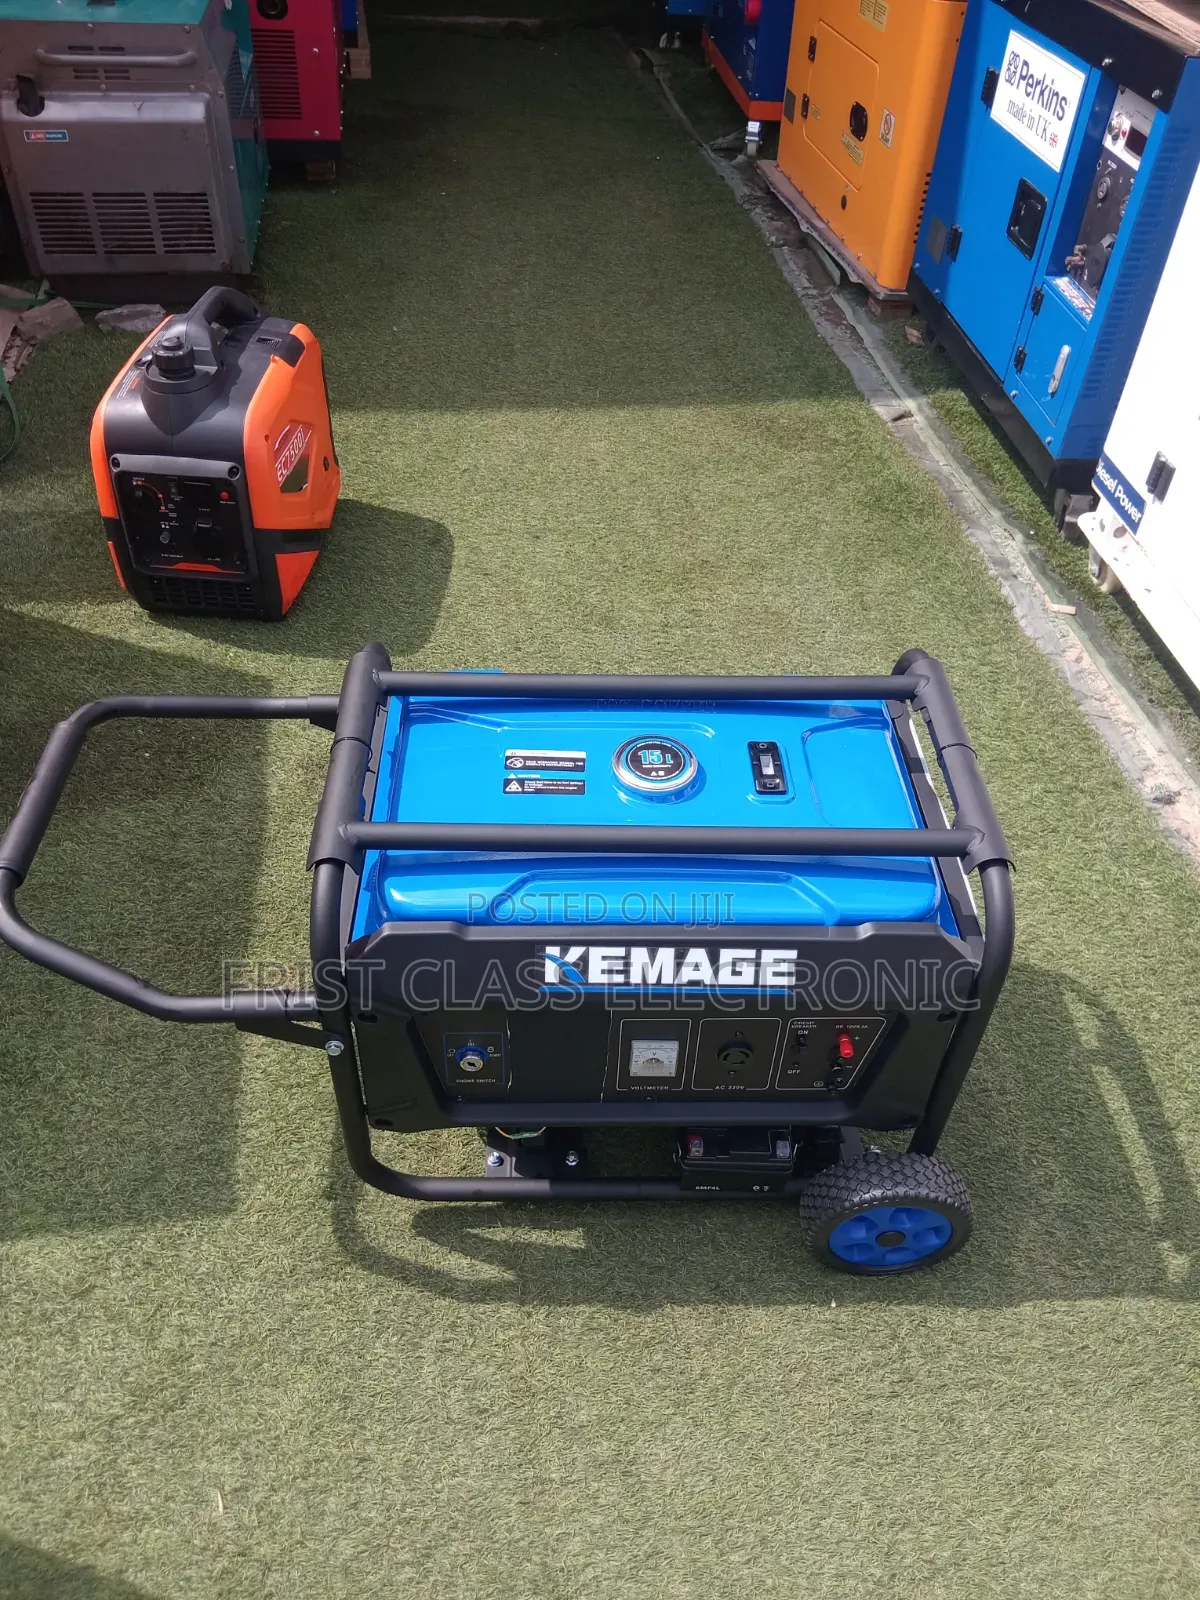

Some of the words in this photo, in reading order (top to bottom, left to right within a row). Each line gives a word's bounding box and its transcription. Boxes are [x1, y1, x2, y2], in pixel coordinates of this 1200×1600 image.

[1016, 59, 1068, 121] Perkins
[1006, 99, 1028, 124] made
[1026, 108, 1036, 131] in
[1035, 114, 1052, 142] UK
[1096, 458, 1118, 493] iesel
[1114, 484, 1142, 523] Power
[638, 749, 664, 764] 15
[541, 945, 799, 986] KEMAGE
